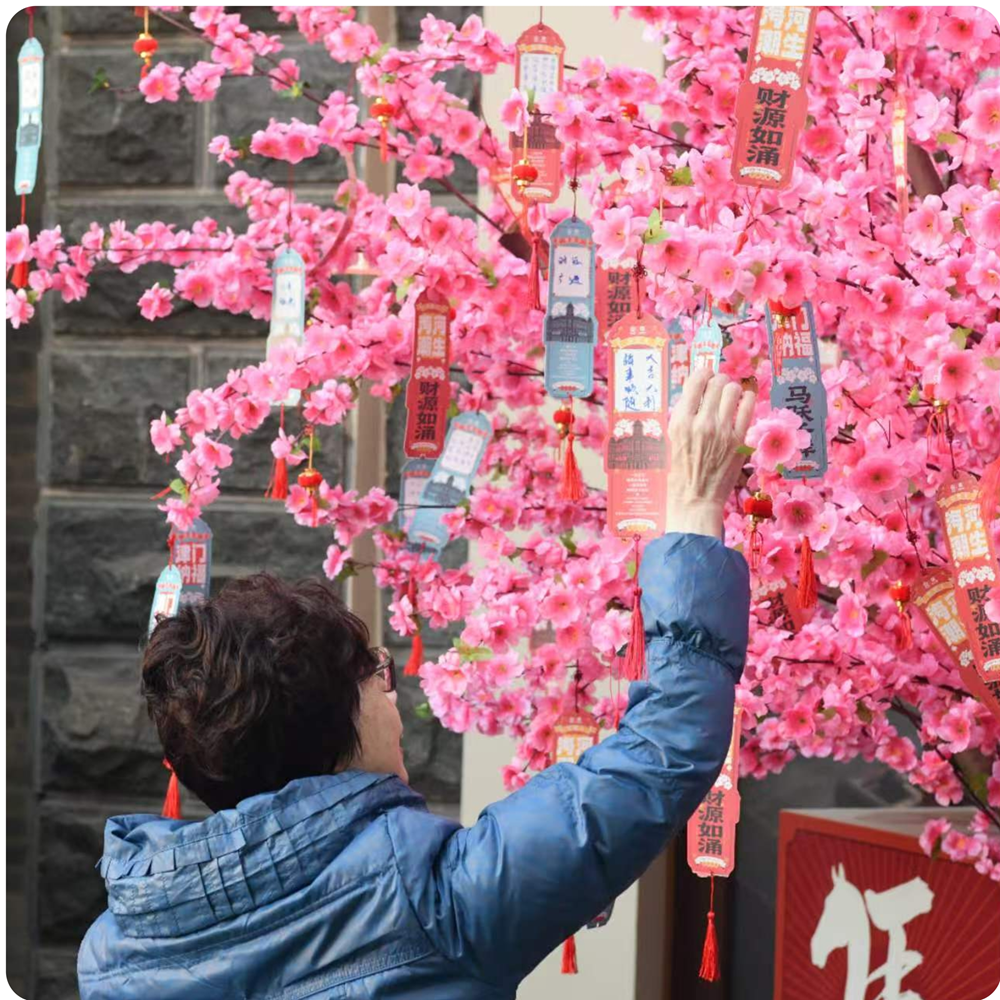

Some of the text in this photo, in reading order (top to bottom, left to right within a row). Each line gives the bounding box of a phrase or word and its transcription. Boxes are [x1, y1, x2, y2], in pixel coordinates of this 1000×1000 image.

[746, 87, 791, 167] 财源如涌
[414, 381, 440, 441] 财源如涌
